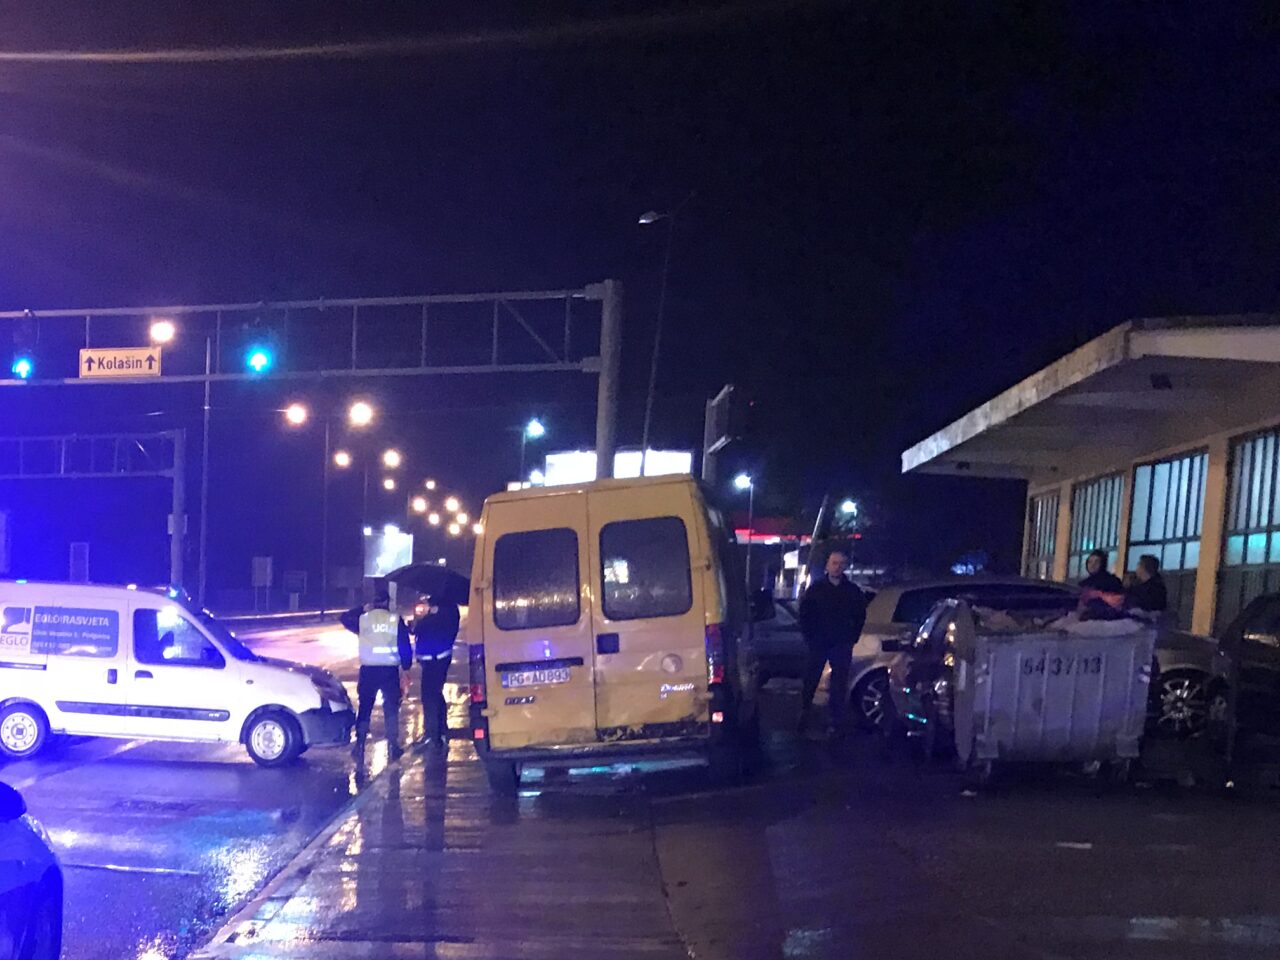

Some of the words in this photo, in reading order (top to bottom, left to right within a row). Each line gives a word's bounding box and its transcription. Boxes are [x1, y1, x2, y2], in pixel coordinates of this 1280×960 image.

[97, 355, 143, 370] Kolašin
[35, 613, 60, 624] EGLO
[62, 615, 110, 627] RASVJETA
[0, 635, 29, 647] EGLO
[509, 672, 525, 686] PG
